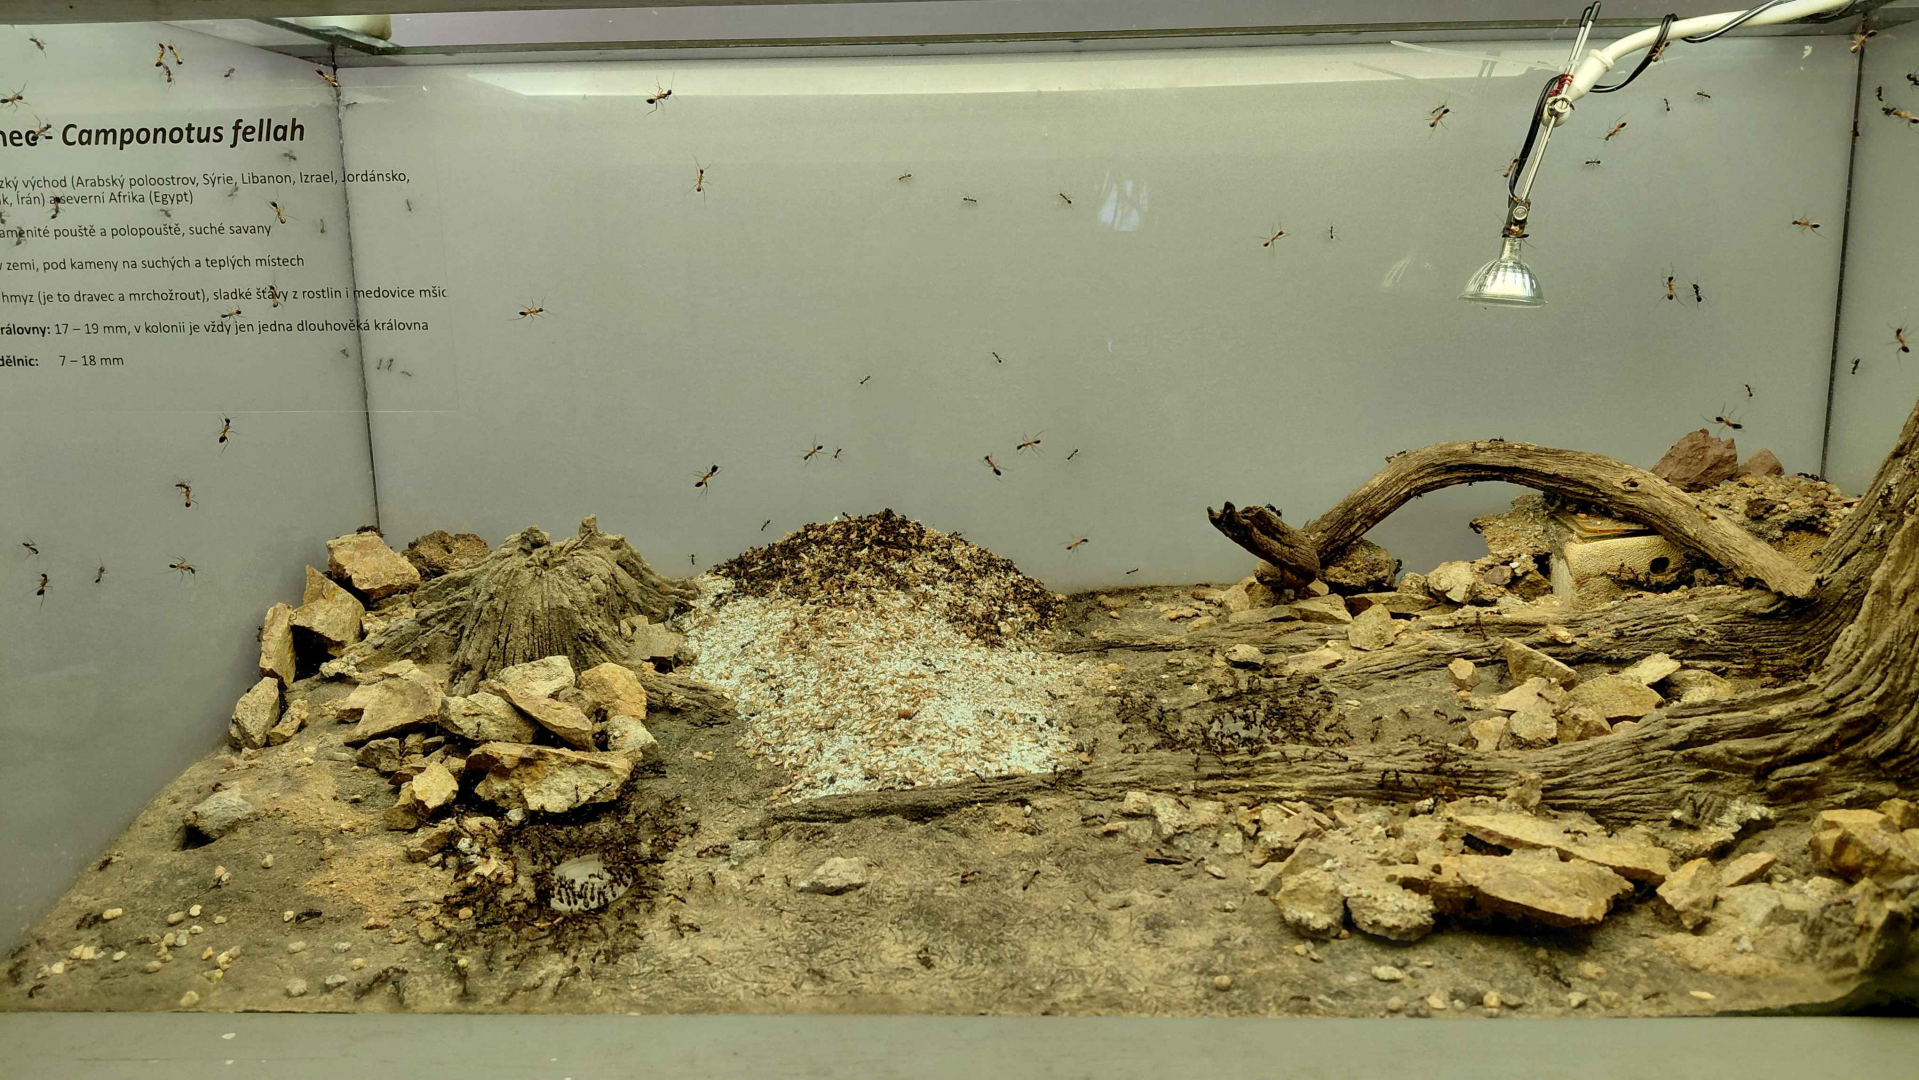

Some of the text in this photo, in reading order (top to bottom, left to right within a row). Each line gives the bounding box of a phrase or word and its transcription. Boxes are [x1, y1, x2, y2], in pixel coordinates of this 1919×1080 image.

[61, 122, 224, 150] Camponotus
[229, 117, 305, 148] fellah
[22, 175, 67, 191] východ
[72, 174, 125, 190] (Arabský
[129, 174, 199, 189] poloostrov,
[202, 172, 238, 187] Sýrie,
[241, 171, 296, 186] Libanon,
[299, 170, 338, 185] Izrael,
[341, 169, 411, 184] Jordánsko,
[16, 191, 45, 207] Írán)
[59, 191, 105, 205] severní
[109, 190, 145, 204] Afrika
[149, 190, 194, 205] (Egypt)
[54, 224, 96, 241] pouště
[100, 227, 107, 237] a
[111, 223, 186, 239] polopouště,
[189, 222, 225, 236] suché
[228, 224, 272, 237] savany
[6, 258, 39, 272] zemi,
[43, 258, 67, 273] pod
[70, 258, 119, 272] kameny
[122, 260, 138, 270] na
[141, 256, 191, 271] suchých
[194, 258, 202, 268] a
[205, 255, 251, 270] teplých
[255, 254, 305, 267] místech
[1, 291, 34, 305] hmyz
[38, 290, 54, 306] (je
[57, 292, 71, 303] to
[74, 290, 115, 303] dravec
[118, 293, 125, 302] a
[129, 288, 210, 303] mrchožrout),
[213, 287, 252, 301] sladké
[292, 291, 299, 300] z
[302, 287, 342, 299] rostlin
[353, 286, 415, 299] medovice
[54, 323, 69, 335] 17
[84, 323, 99, 335] 19
[103, 324, 131, 336] mm,
[133, 324, 141, 334] v
[145, 322, 186, 334] kolonii
[188, 322, 201, 336] je
[203, 320, 231, 336] vždy
[234, 320, 254, 335] jen
[258, 320, 293, 335] jedna
[296, 318, 370, 332] dlouhověká
[373, 318, 429, 331] královna
[58, 355, 66, 367] 7
[81, 354, 97, 367] 18
[100, 355, 125, 366] mm
